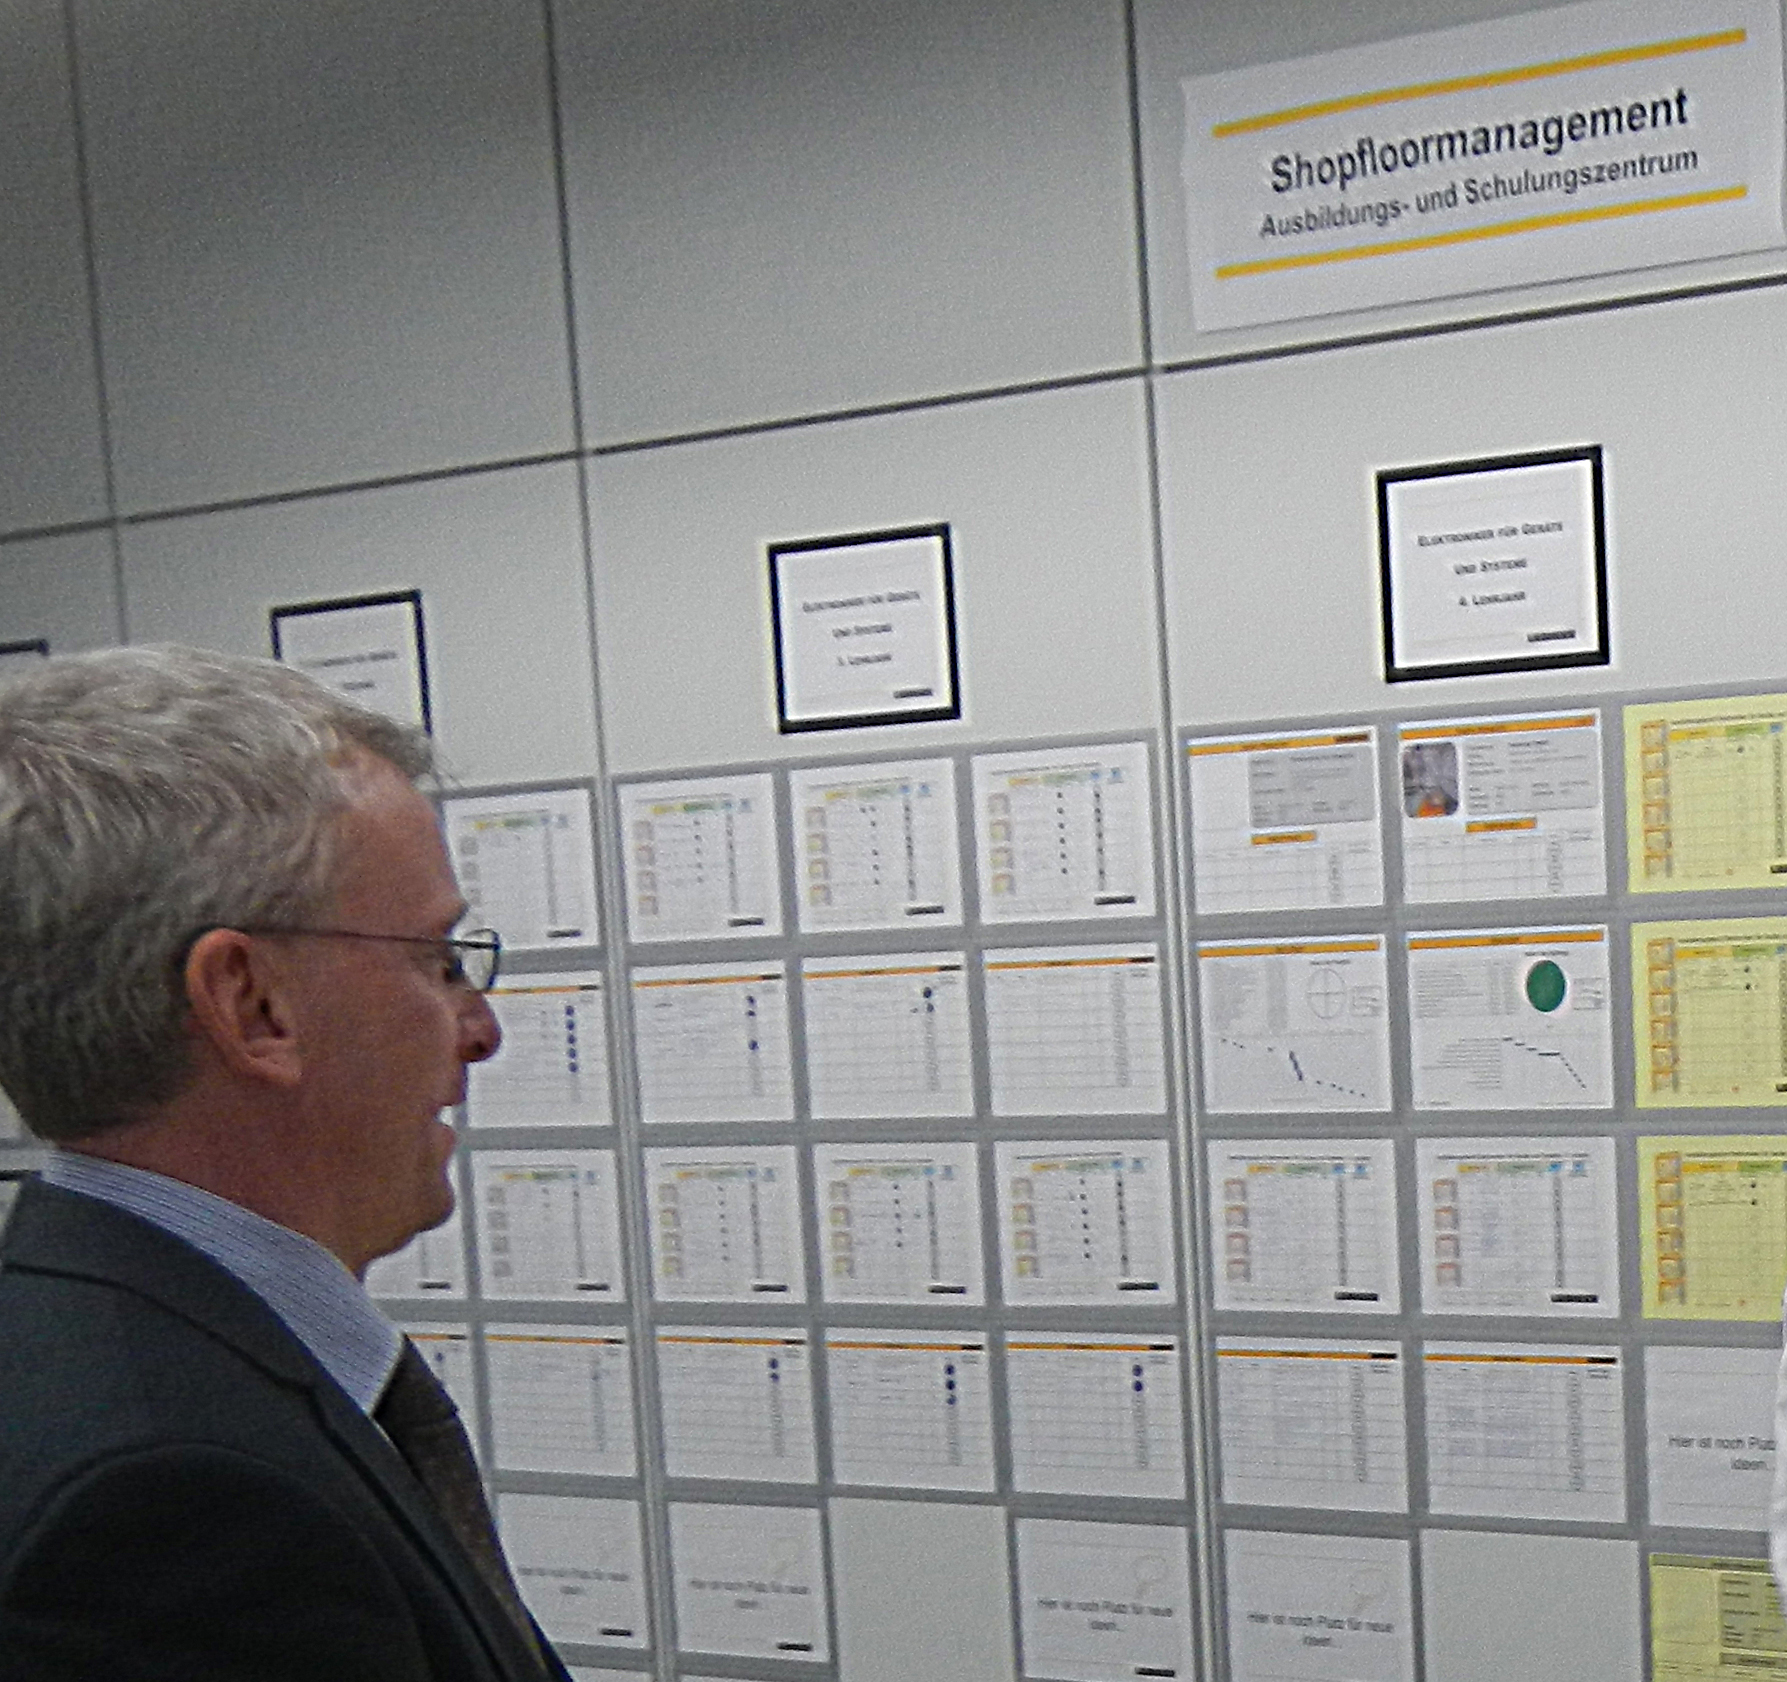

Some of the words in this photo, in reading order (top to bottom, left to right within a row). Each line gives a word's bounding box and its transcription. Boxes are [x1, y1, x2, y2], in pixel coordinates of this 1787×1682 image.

[1269, 87, 1689, 194] Shopfloormanagement
[1259, 193, 1410, 239] Ausbildungs-
[1416, 184, 1459, 214] und
[1464, 149, 1698, 202] Schulungszentrum
